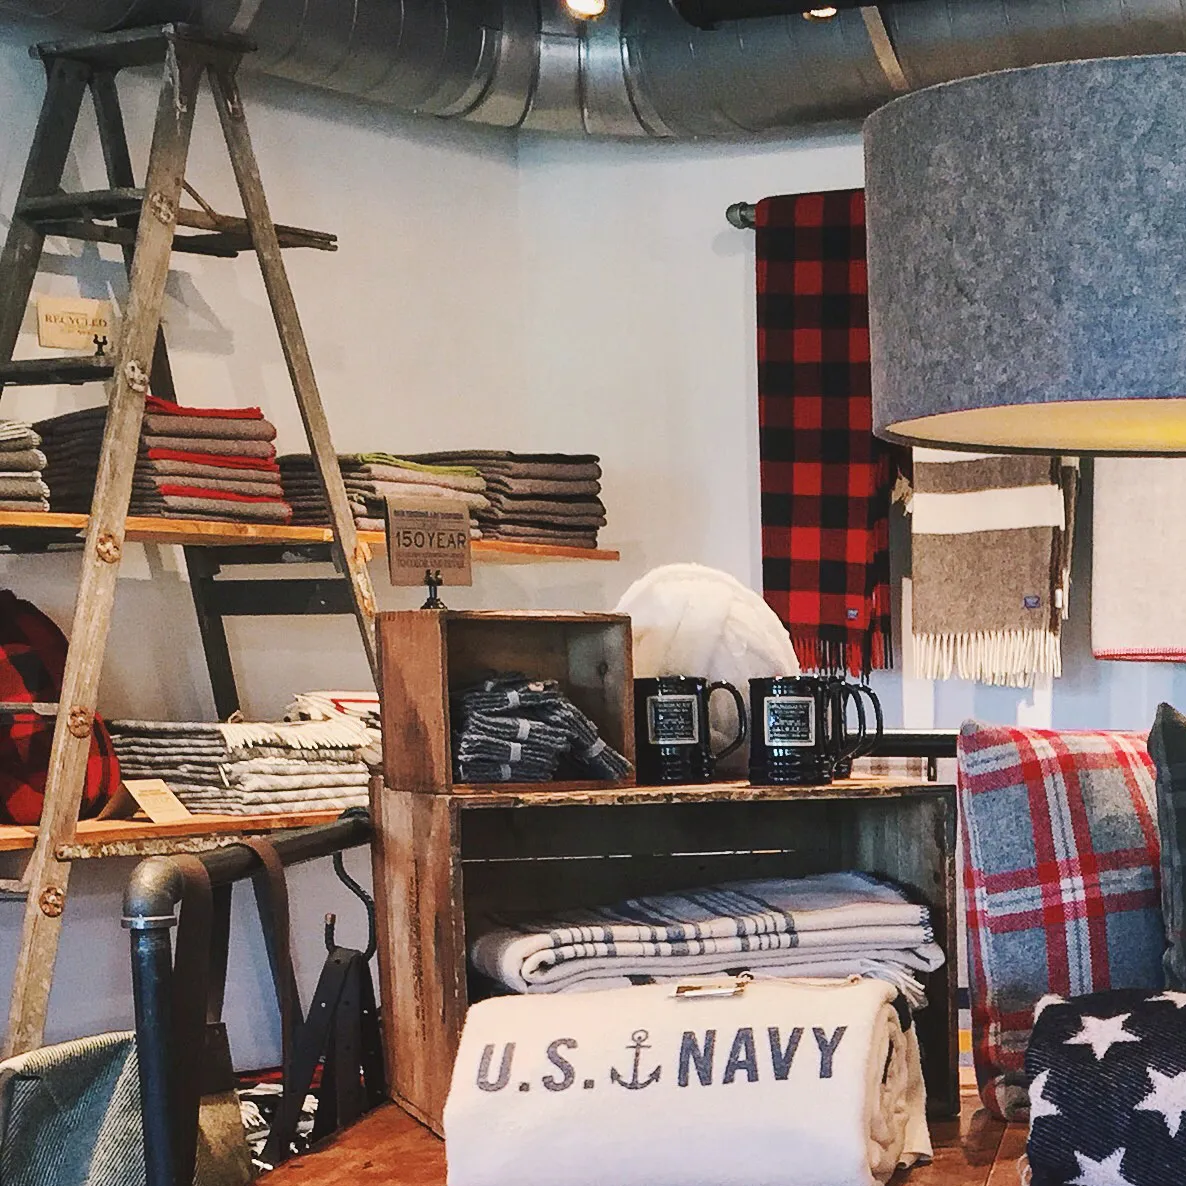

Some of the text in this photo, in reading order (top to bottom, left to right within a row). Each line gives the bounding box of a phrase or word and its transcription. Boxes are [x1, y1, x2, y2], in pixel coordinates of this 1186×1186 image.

[44, 314, 108, 327] RECYCLED
[427, 532, 467, 549] YEAR
[475, 1025, 848, 1093] U.S. NAVY
